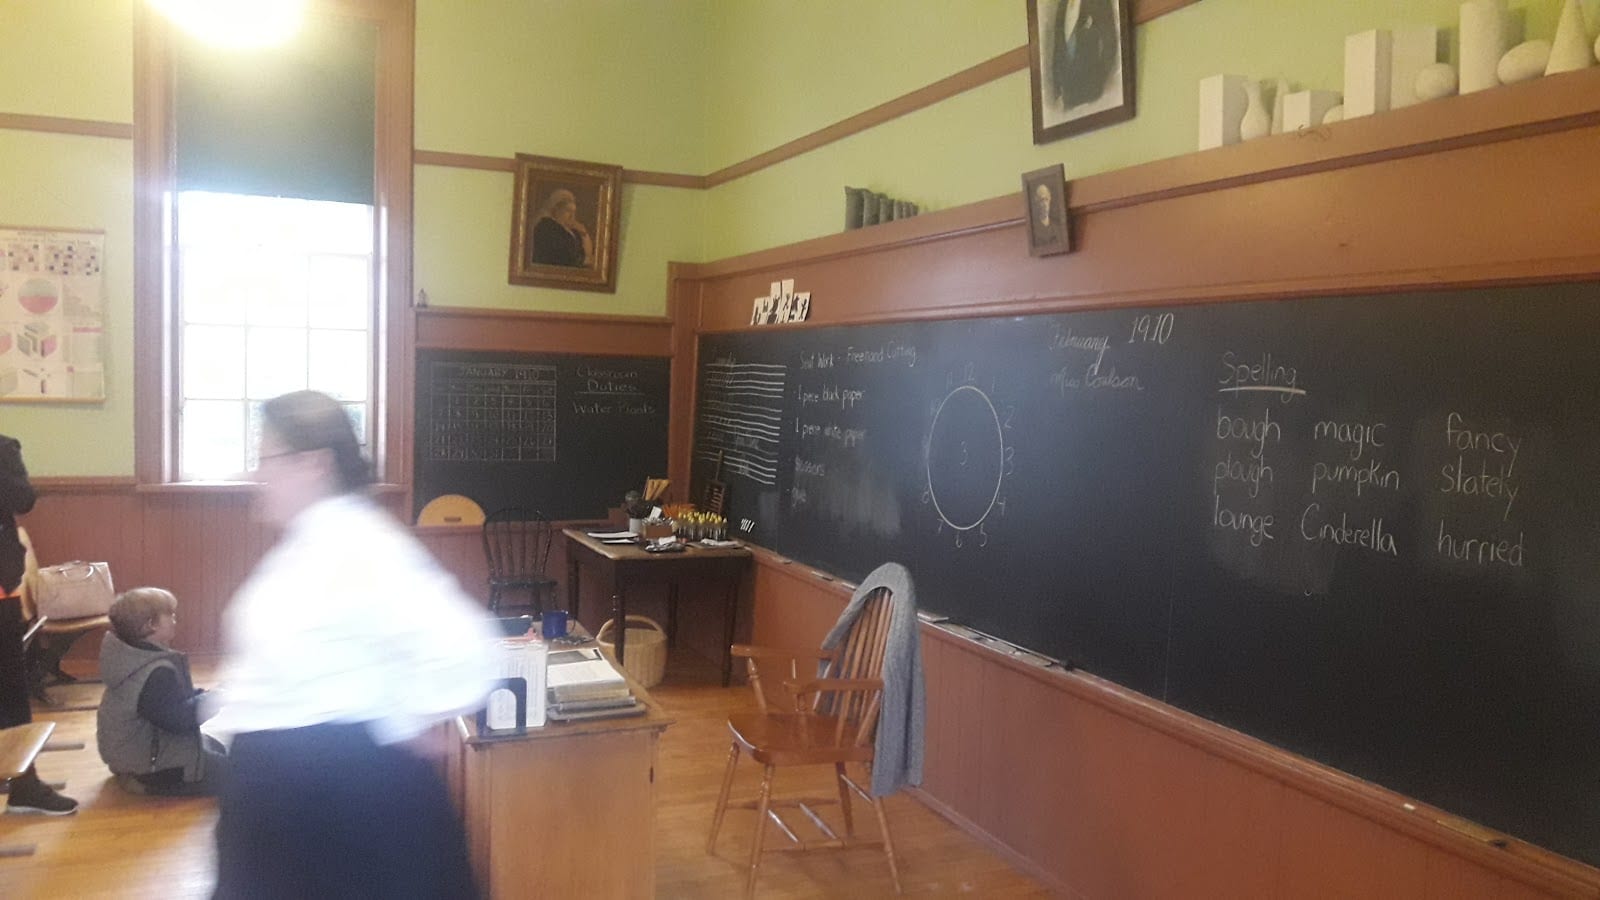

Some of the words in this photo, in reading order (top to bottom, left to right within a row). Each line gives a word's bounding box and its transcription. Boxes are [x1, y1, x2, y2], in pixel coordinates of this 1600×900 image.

[1128, 312, 1174, 345] 1910
[587, 378, 637, 392] Duties
[1218, 351, 1297, 404] Spelling
[572, 401, 612, 414] Water
[1004, 405, 1015, 429] 2
[1216, 407, 1281, 459] bough
[1314, 420, 1386, 461] magic
[1447, 412, 1522, 478] fancy
[1005, 446, 1015, 476] 3
[1213, 452, 1273, 498] plough
[1311, 458, 1400, 497] pumpkin
[997, 492, 1007, 516] 4
[1213, 494, 1275, 547] lounge
[956, 530, 963, 548] 6
[979, 522, 988, 548] 5
[1300, 502, 1397, 556] Cinderella
[1437, 518, 1523, 567] hurried
